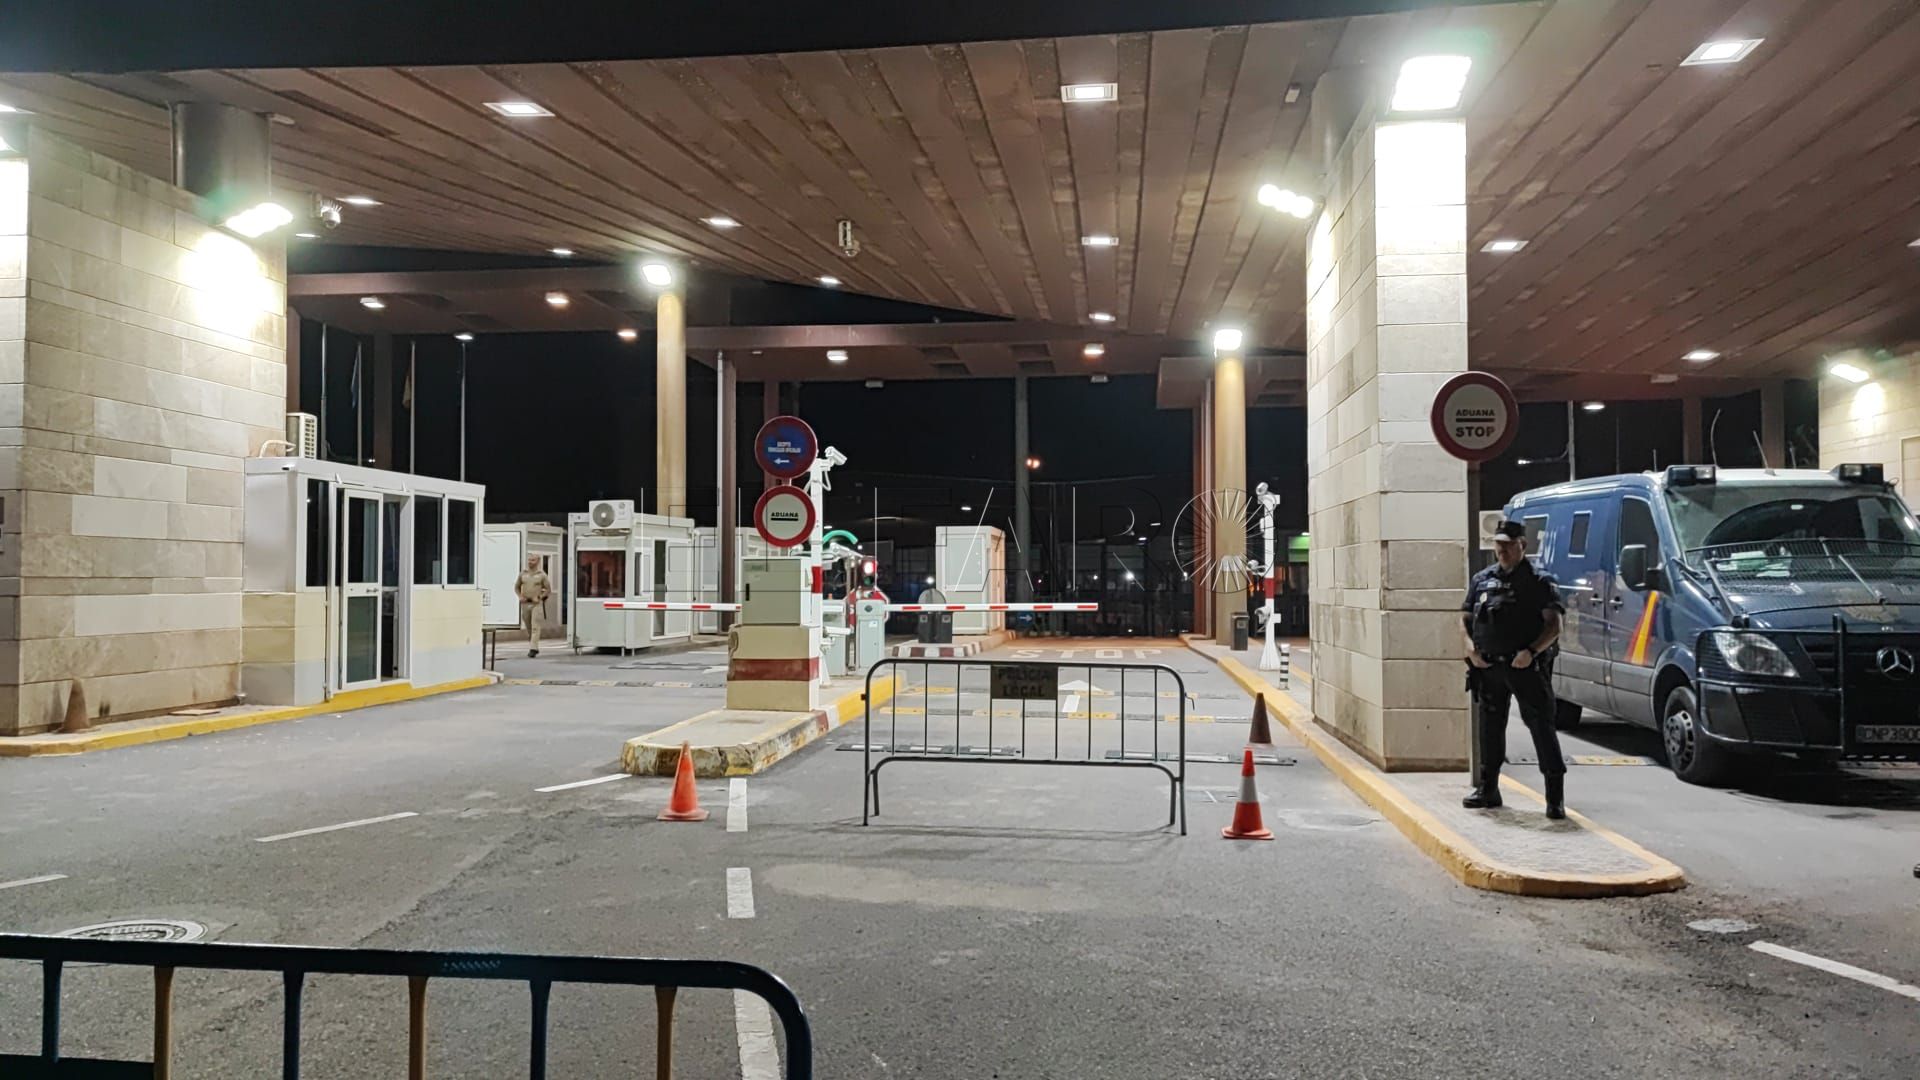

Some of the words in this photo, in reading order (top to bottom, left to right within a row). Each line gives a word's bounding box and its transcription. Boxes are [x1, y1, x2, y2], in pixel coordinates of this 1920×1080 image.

[1456, 409, 1495, 417] ADUANA
[1456, 426, 1496, 438] STOP
[1009, 649, 1162, 660] STOP
